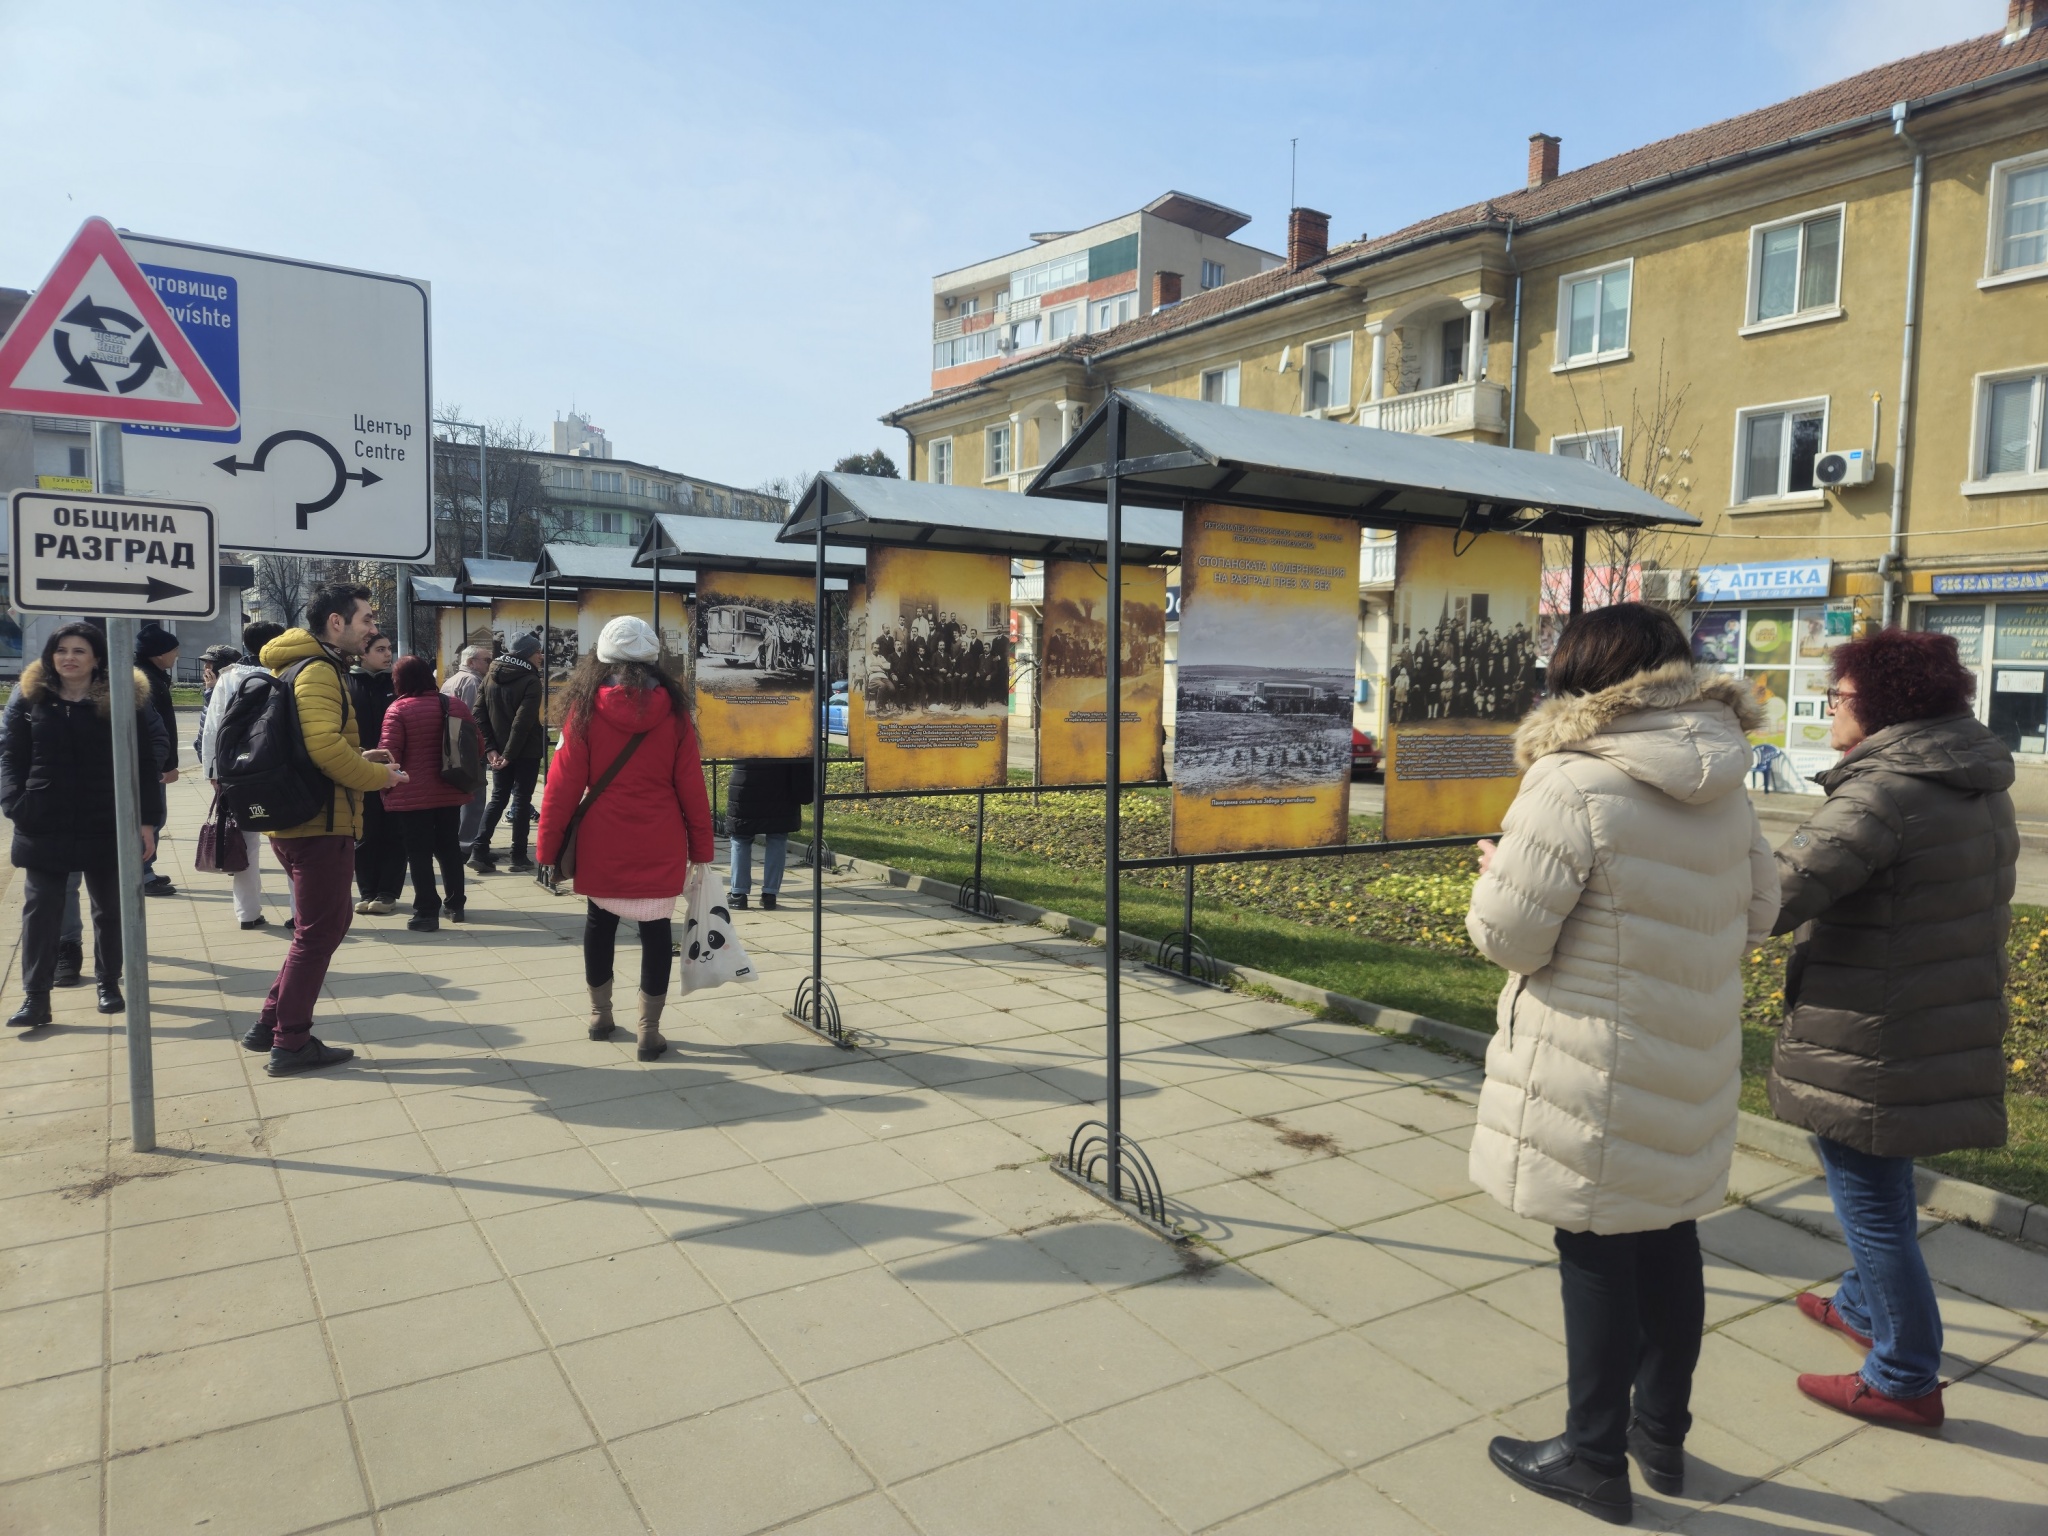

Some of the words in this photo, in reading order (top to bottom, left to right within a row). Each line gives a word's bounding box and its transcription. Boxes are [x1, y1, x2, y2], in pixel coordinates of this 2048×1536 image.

[354, 414, 411, 440] Център
[355, 440, 405, 461] Centre
[54, 507, 176, 534] ОБЩИНА
[35, 533, 195, 570] РАЗГРАД
[1198, 556, 1267, 571] СТОПАНСКАТА
[1271, 561, 1345, 577] МОДЕРНИЗАЦИЯ
[1214, 572, 1227, 583] НА
[1231, 573, 1270, 587] РАЗГРАД
[1273, 577, 1297, 589] ПРЕЗ
[1314, 580, 1331, 591] ВЕК
[1729, 569, 1821, 588] АПТЕКА
[504, 655, 532, 670] SQUAD
